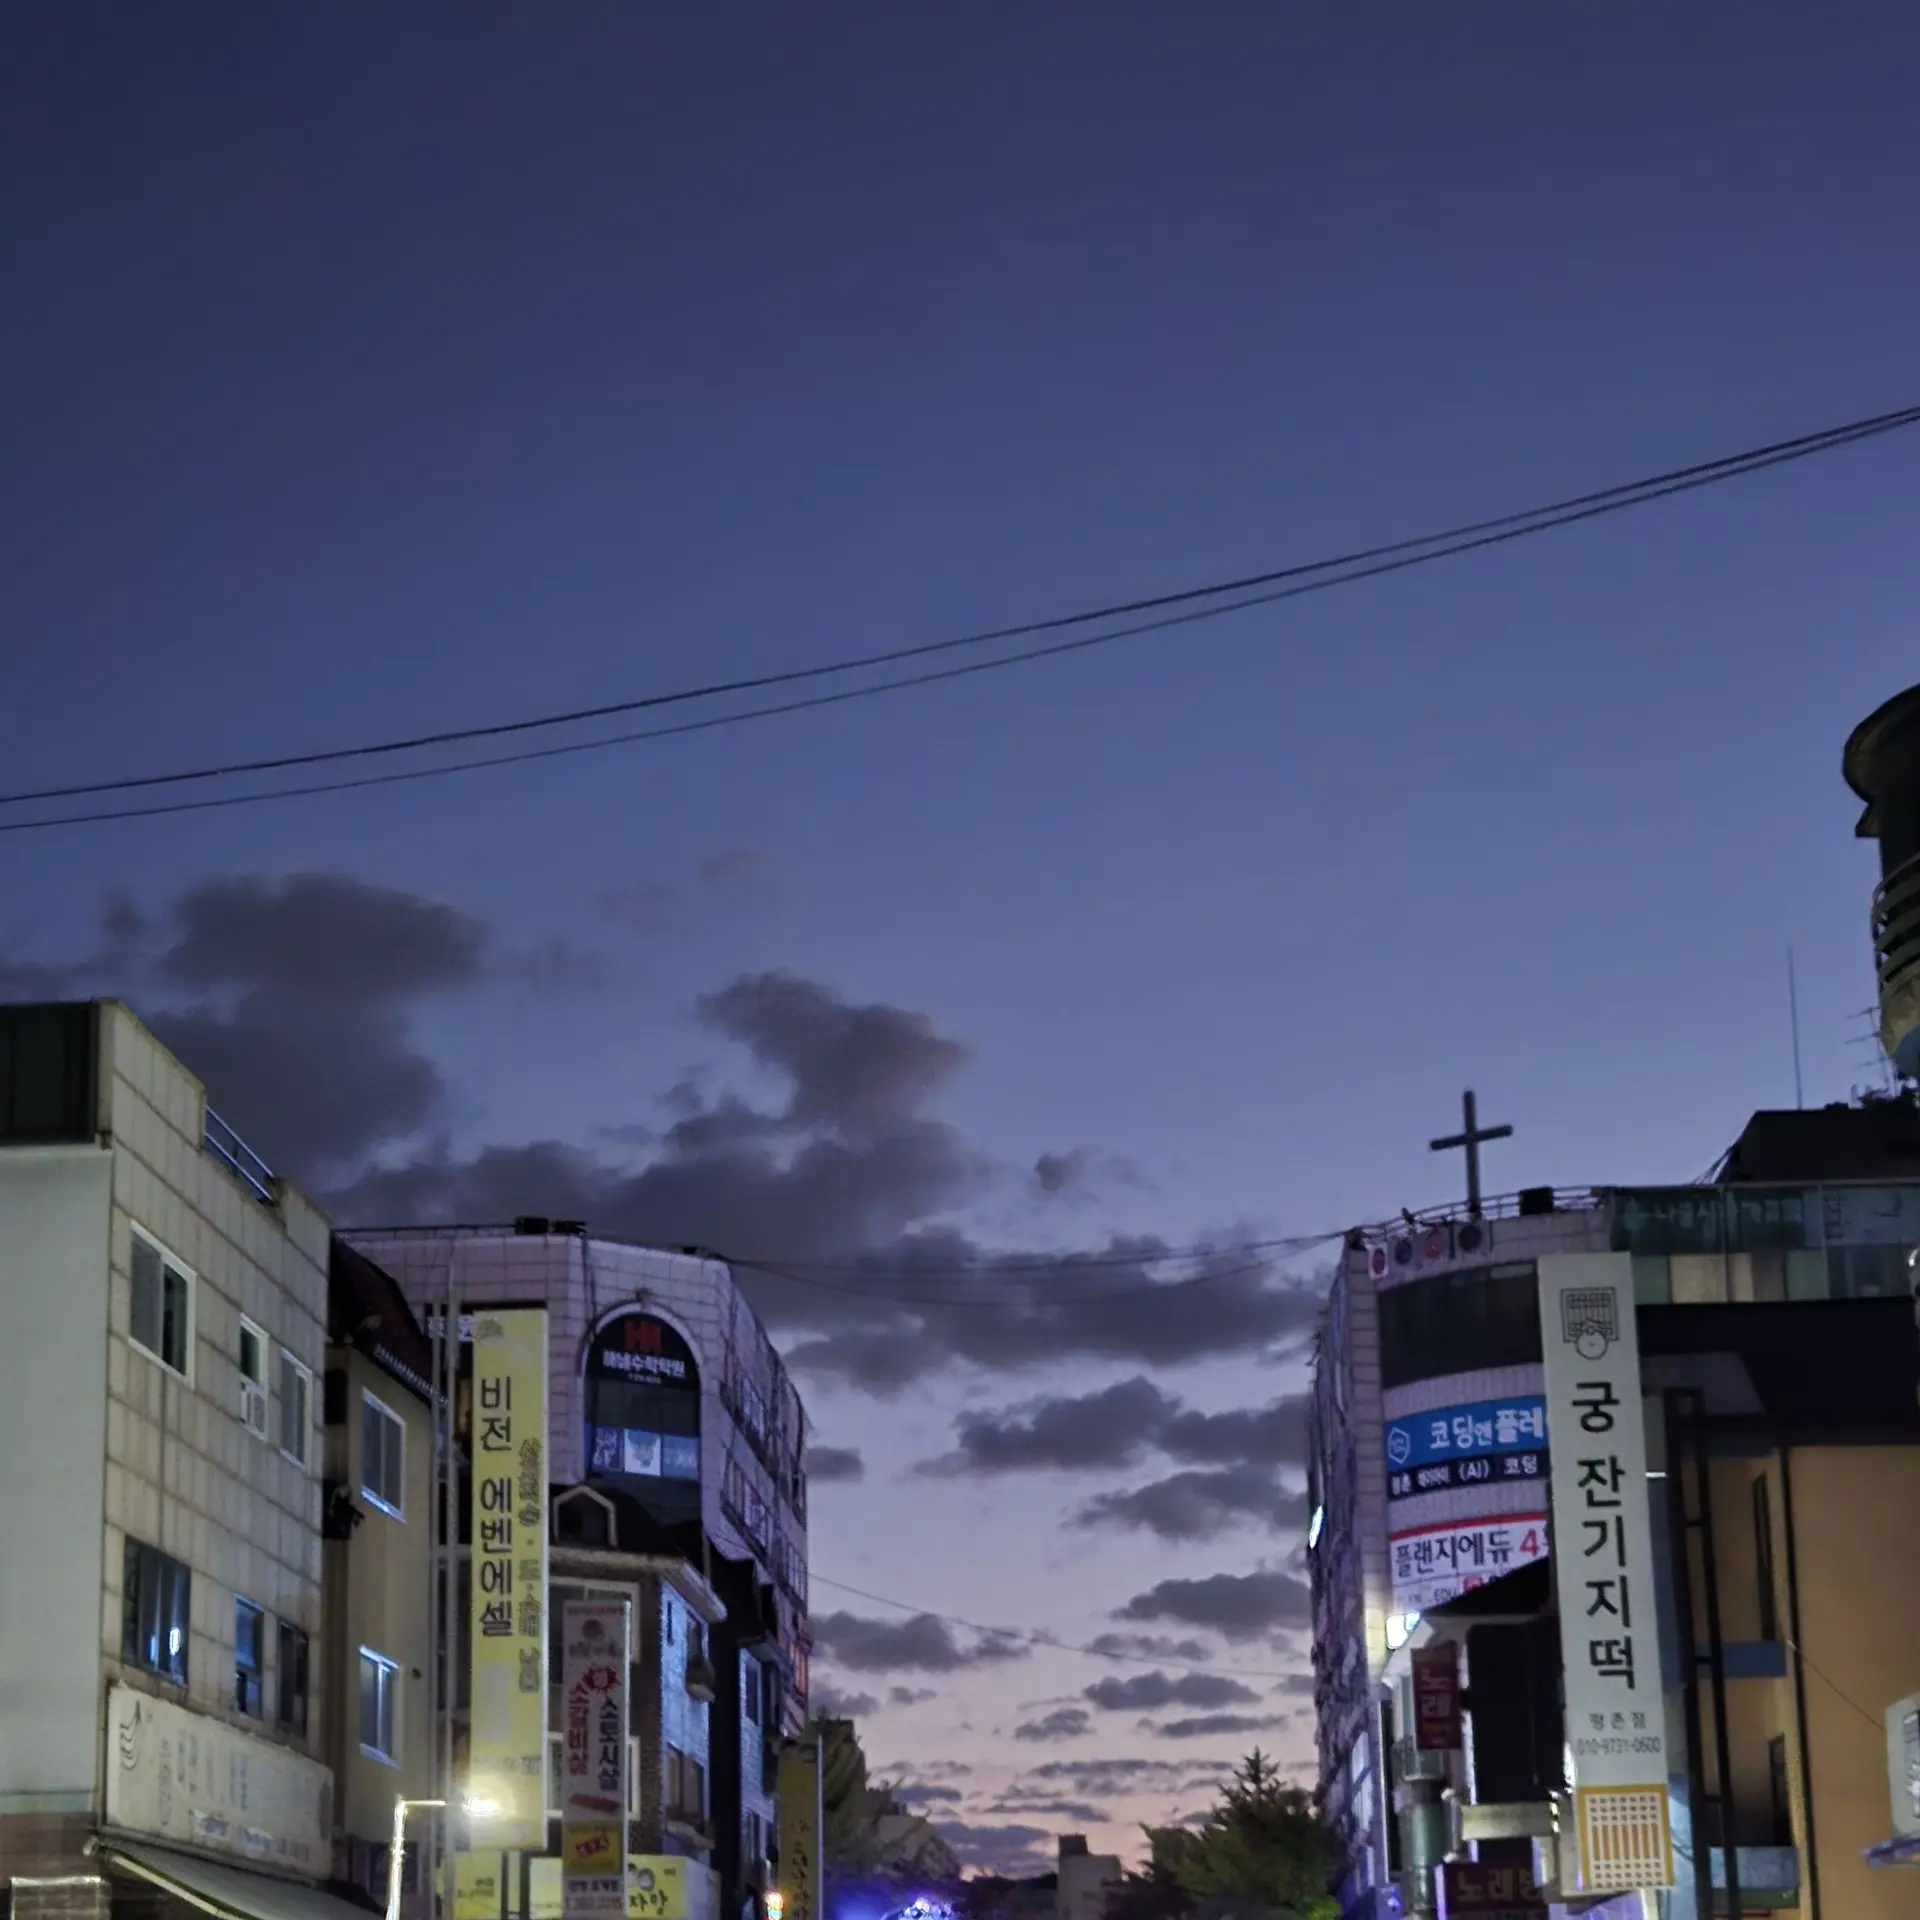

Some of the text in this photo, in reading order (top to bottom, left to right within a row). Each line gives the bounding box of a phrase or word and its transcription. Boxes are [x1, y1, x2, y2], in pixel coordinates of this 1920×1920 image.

[479, 1376, 513, 1637] 비전 에벤에셀
[1395, 1530, 1514, 1578] 플랜지에듀
[1572, 1382, 1635, 1690] 궁 잔기지떡
